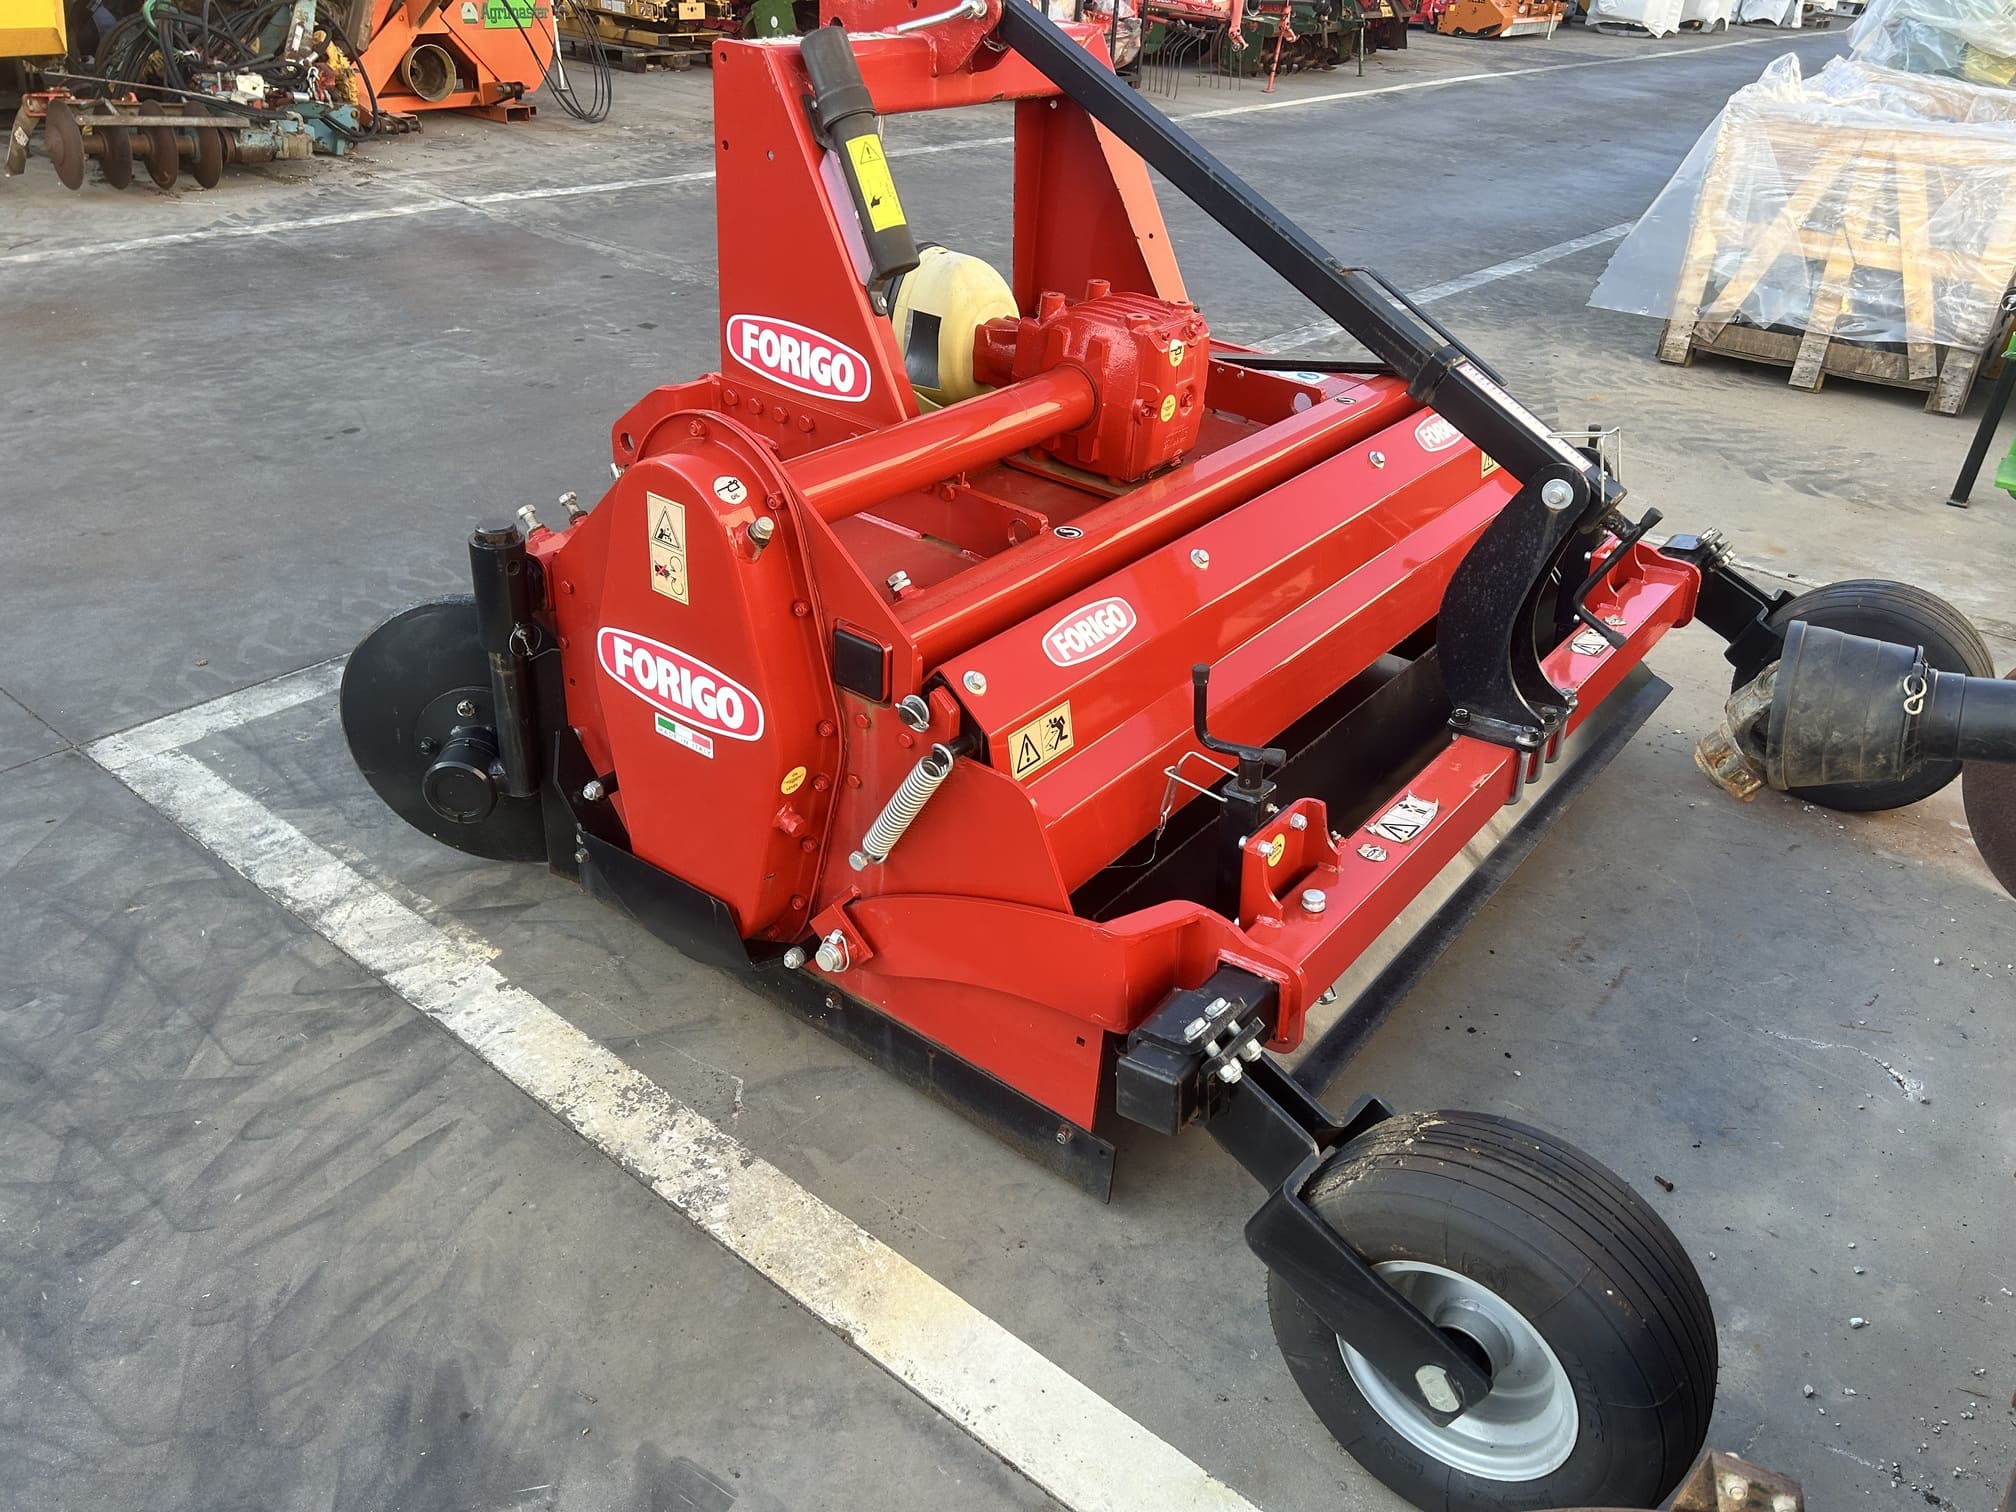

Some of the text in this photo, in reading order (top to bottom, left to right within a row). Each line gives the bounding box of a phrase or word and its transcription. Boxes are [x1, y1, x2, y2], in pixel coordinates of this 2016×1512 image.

[742, 321, 855, 393] FORIGO
[1051, 603, 1128, 661] FORIGO
[613, 635, 745, 730] FORIGO
